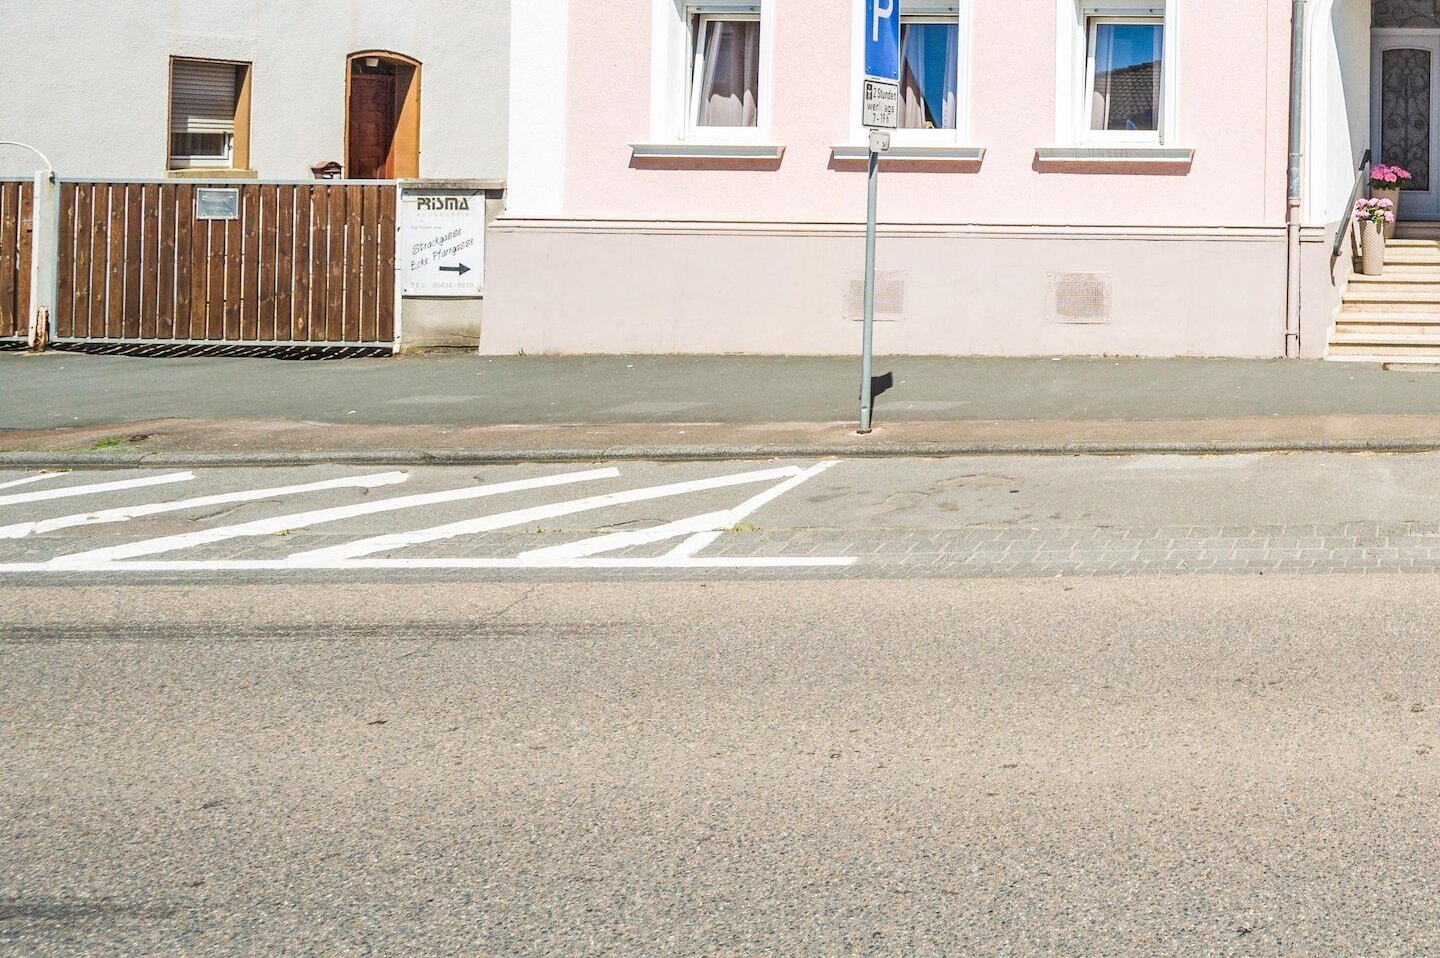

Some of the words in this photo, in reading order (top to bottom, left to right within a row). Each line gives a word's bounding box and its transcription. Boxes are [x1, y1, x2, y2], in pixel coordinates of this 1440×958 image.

[877, 87, 897, 101] Stunden
[411, 228, 462, 255] Strackgasse
[411, 257, 429, 271] Ecke
[432, 238, 474, 261] Pfarrgasse
